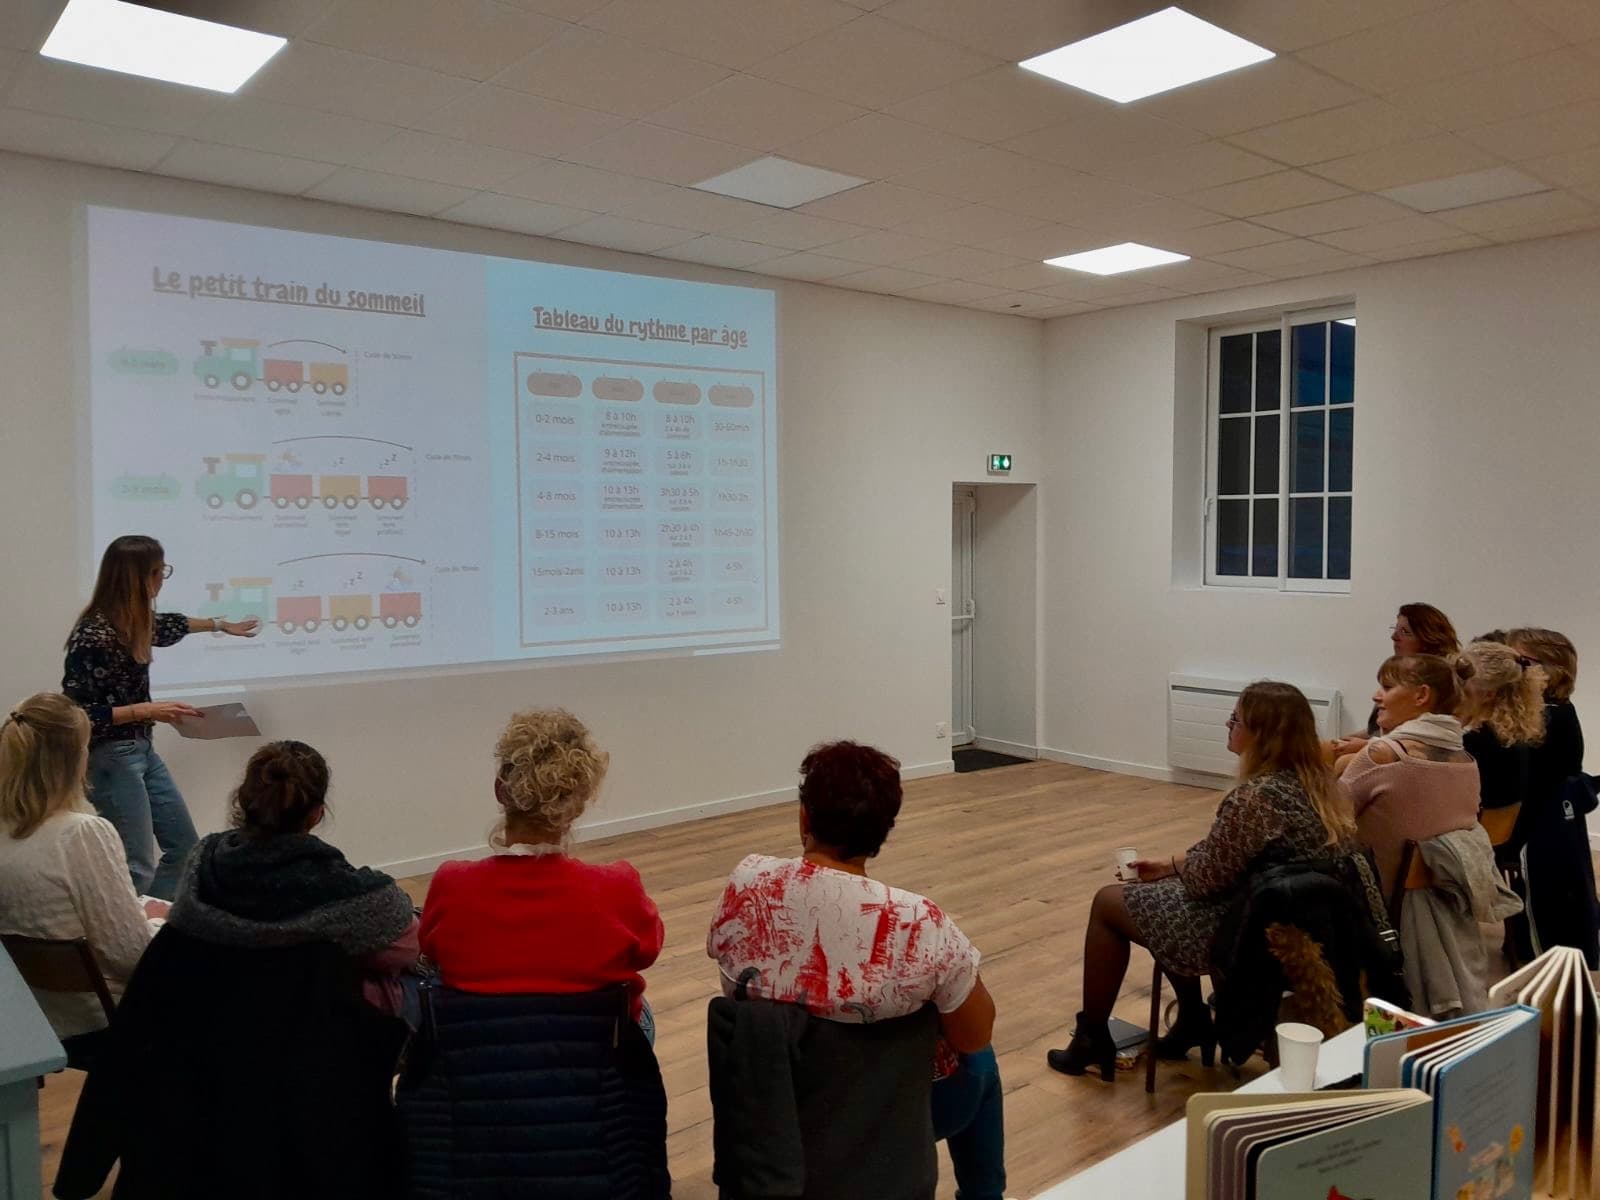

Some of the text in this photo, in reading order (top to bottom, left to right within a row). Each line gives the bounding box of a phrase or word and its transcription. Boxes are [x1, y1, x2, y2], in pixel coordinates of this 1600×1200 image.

[153, 266, 425, 314] Le petit train du sommeil
[533, 306, 748, 349] Tableau du rythme par âge
